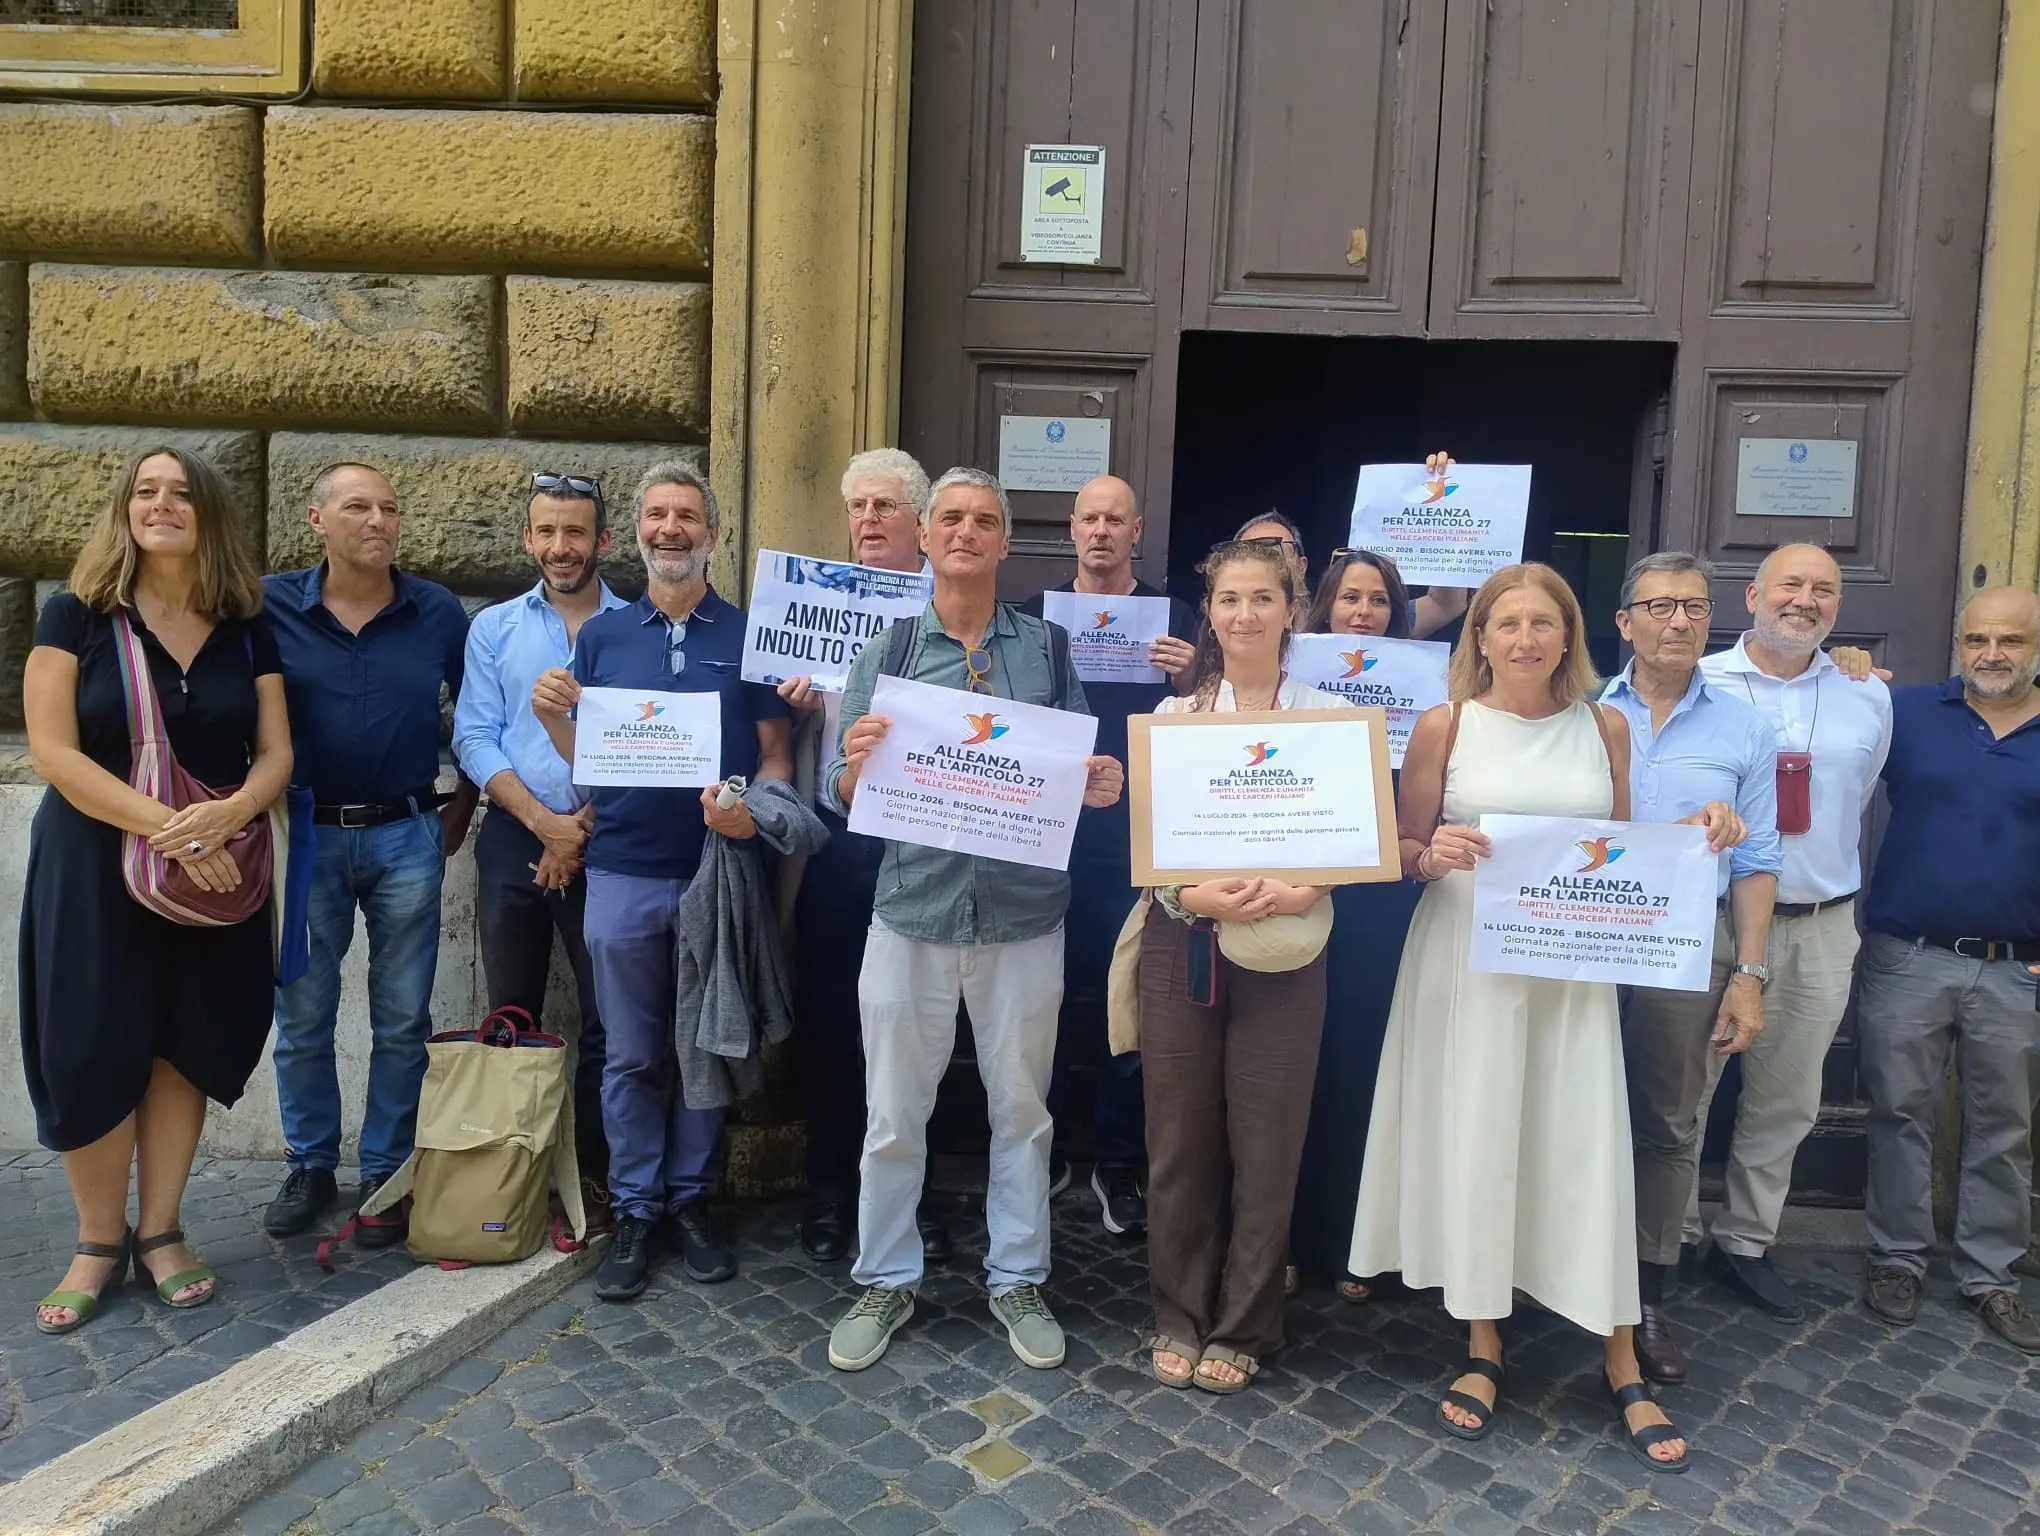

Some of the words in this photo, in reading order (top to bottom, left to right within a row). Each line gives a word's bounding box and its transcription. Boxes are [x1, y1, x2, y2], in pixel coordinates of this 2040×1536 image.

[1033, 151, 1095, 162] ATTENZIONE!
[1402, 507, 1471, 518] ALLEANZA
[1383, 517, 1404, 526] PER
[1407, 517, 1474, 528] L'ARTICOLO
[1476, 519, 1491, 528] 27
[871, 574, 900, 584] CLEMENZA
[900, 578, 904, 586] E
[784, 602, 884, 638] AMNISTIA
[1080, 631, 1126, 640] ALLEANZA
[1084, 638, 1128, 646] L'ARTICOLO
[756, 626, 844, 664] INDULTO
[1318, 681, 1392, 695] ALLEANZA
[1400, 698, 1414, 707] 27
[620, 724, 676, 732] ALLEANZA
[624, 732, 679, 740] L'ARTICOLO
[934, 744, 1021, 772] ALLEANZA
[904, 765, 938, 778] DIRITTI,
[941, 772, 990, 788] CLEMENZA
[906, 752, 936, 767] PER
[940, 759, 1024, 784] L'ARTICOLO
[1028, 776, 1045, 788] 27
[1228, 769, 1294, 778] ALLEANZA
[1235, 778, 1298, 786] L'ARTICOLO
[915, 777, 943, 788] NELLE
[946, 783, 984, 796] CARCERI
[988, 791, 1029, 805] ITALIANE
[867, 784, 878, 792] 14
[880, 786, 918, 800] LUGLIO
[920, 794, 944, 805] 2026
[953, 800, 998, 816] BISOGNA
[1001, 810, 1034, 823] AVERE
[1037, 817, 1065, 828] VISTO
[886, 800, 928, 814] Giornata
[931, 809, 977, 823] nazionale
[980, 818, 996, 827] per
[882, 811, 906, 821] delle
[908, 816, 948, 829] persone
[950, 823, 983, 836] private
[986, 830, 1008, 842] della
[1548, 876, 1644, 893] ALLEANZA
[1520, 886, 1551, 899] PER
[1556, 890, 1648, 906] L'ARTICOLO
[1652, 896, 1669, 907] 27
[1518, 900, 1555, 910] DIRITTI,
[1558, 903, 1612, 913] CLEMENZA
[1531, 911, 1562, 920] NELLE
[1564, 914, 1607, 922] CARCERI
[1610, 917, 1654, 926] ITALIANE
[1496, 923, 1536, 933] LUGLIO
[1539, 927, 1565, 936] 2026
[1575, 930, 1624, 940] BISOGNA
[1628, 934, 1664, 944] AVERE
[1667, 937, 1702, 947] VISTO
[1504, 935, 1549, 946] Giornata
[1553, 941, 1602, 951] nazionale
[1626, 945, 1634, 954] la
[1501, 946, 1526, 956] delle
[1529, 950, 1572, 960] persone
[1575, 954, 1610, 962] private
[1613, 956, 1638, 965] della
